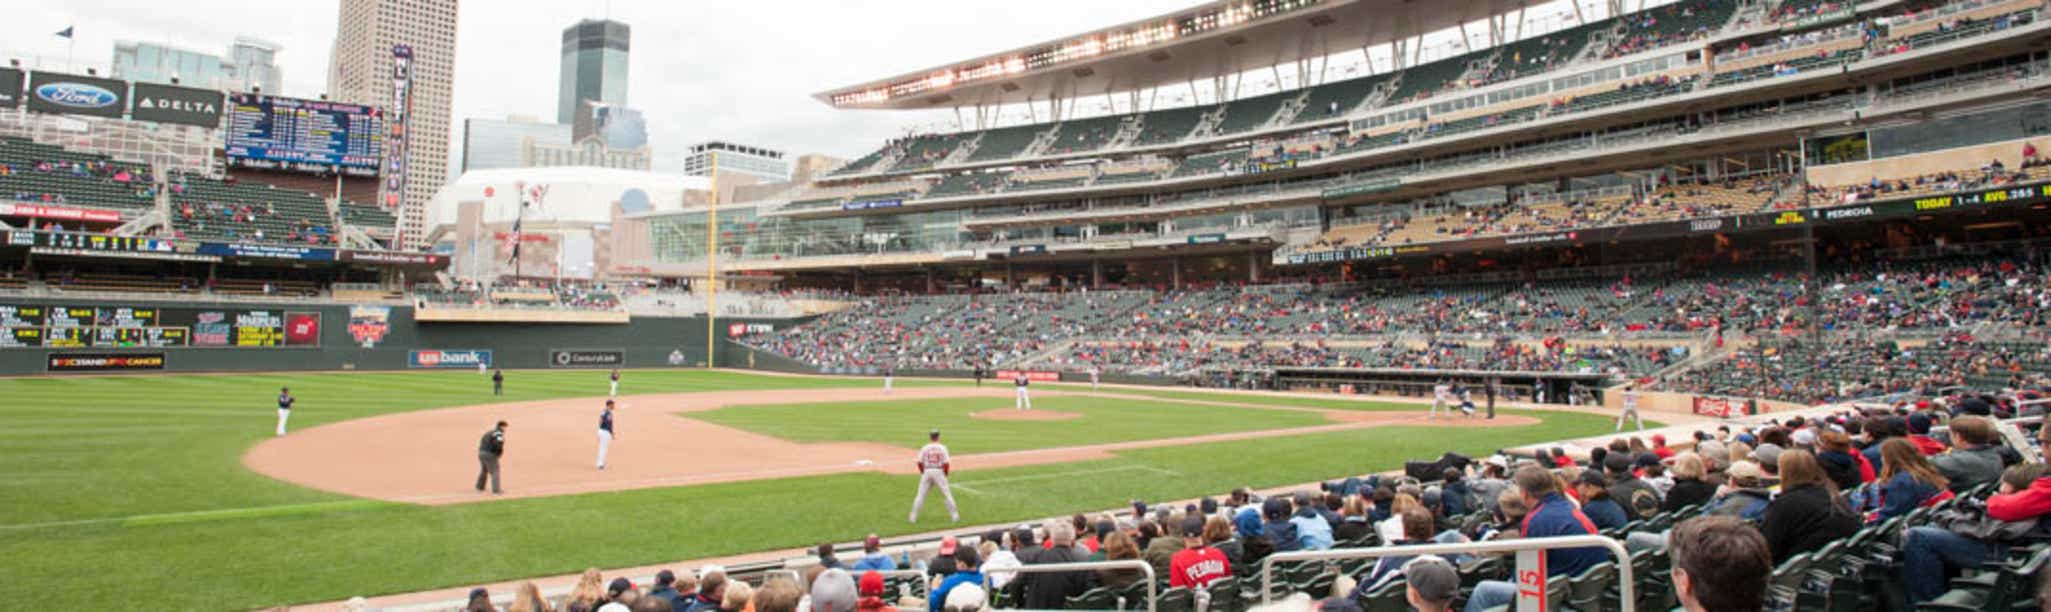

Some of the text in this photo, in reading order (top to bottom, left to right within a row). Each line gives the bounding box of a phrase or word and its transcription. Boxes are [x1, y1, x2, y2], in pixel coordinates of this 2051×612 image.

[51, 84, 101, 106] Ford
[158, 100, 215, 113] DELTA
[1827, 207, 1873, 219] PEDROIA
[1915, 197, 1952, 210] TODAY
[1186, 559, 1225, 581] PEDROIA
[1519, 569, 1541, 598] 15
